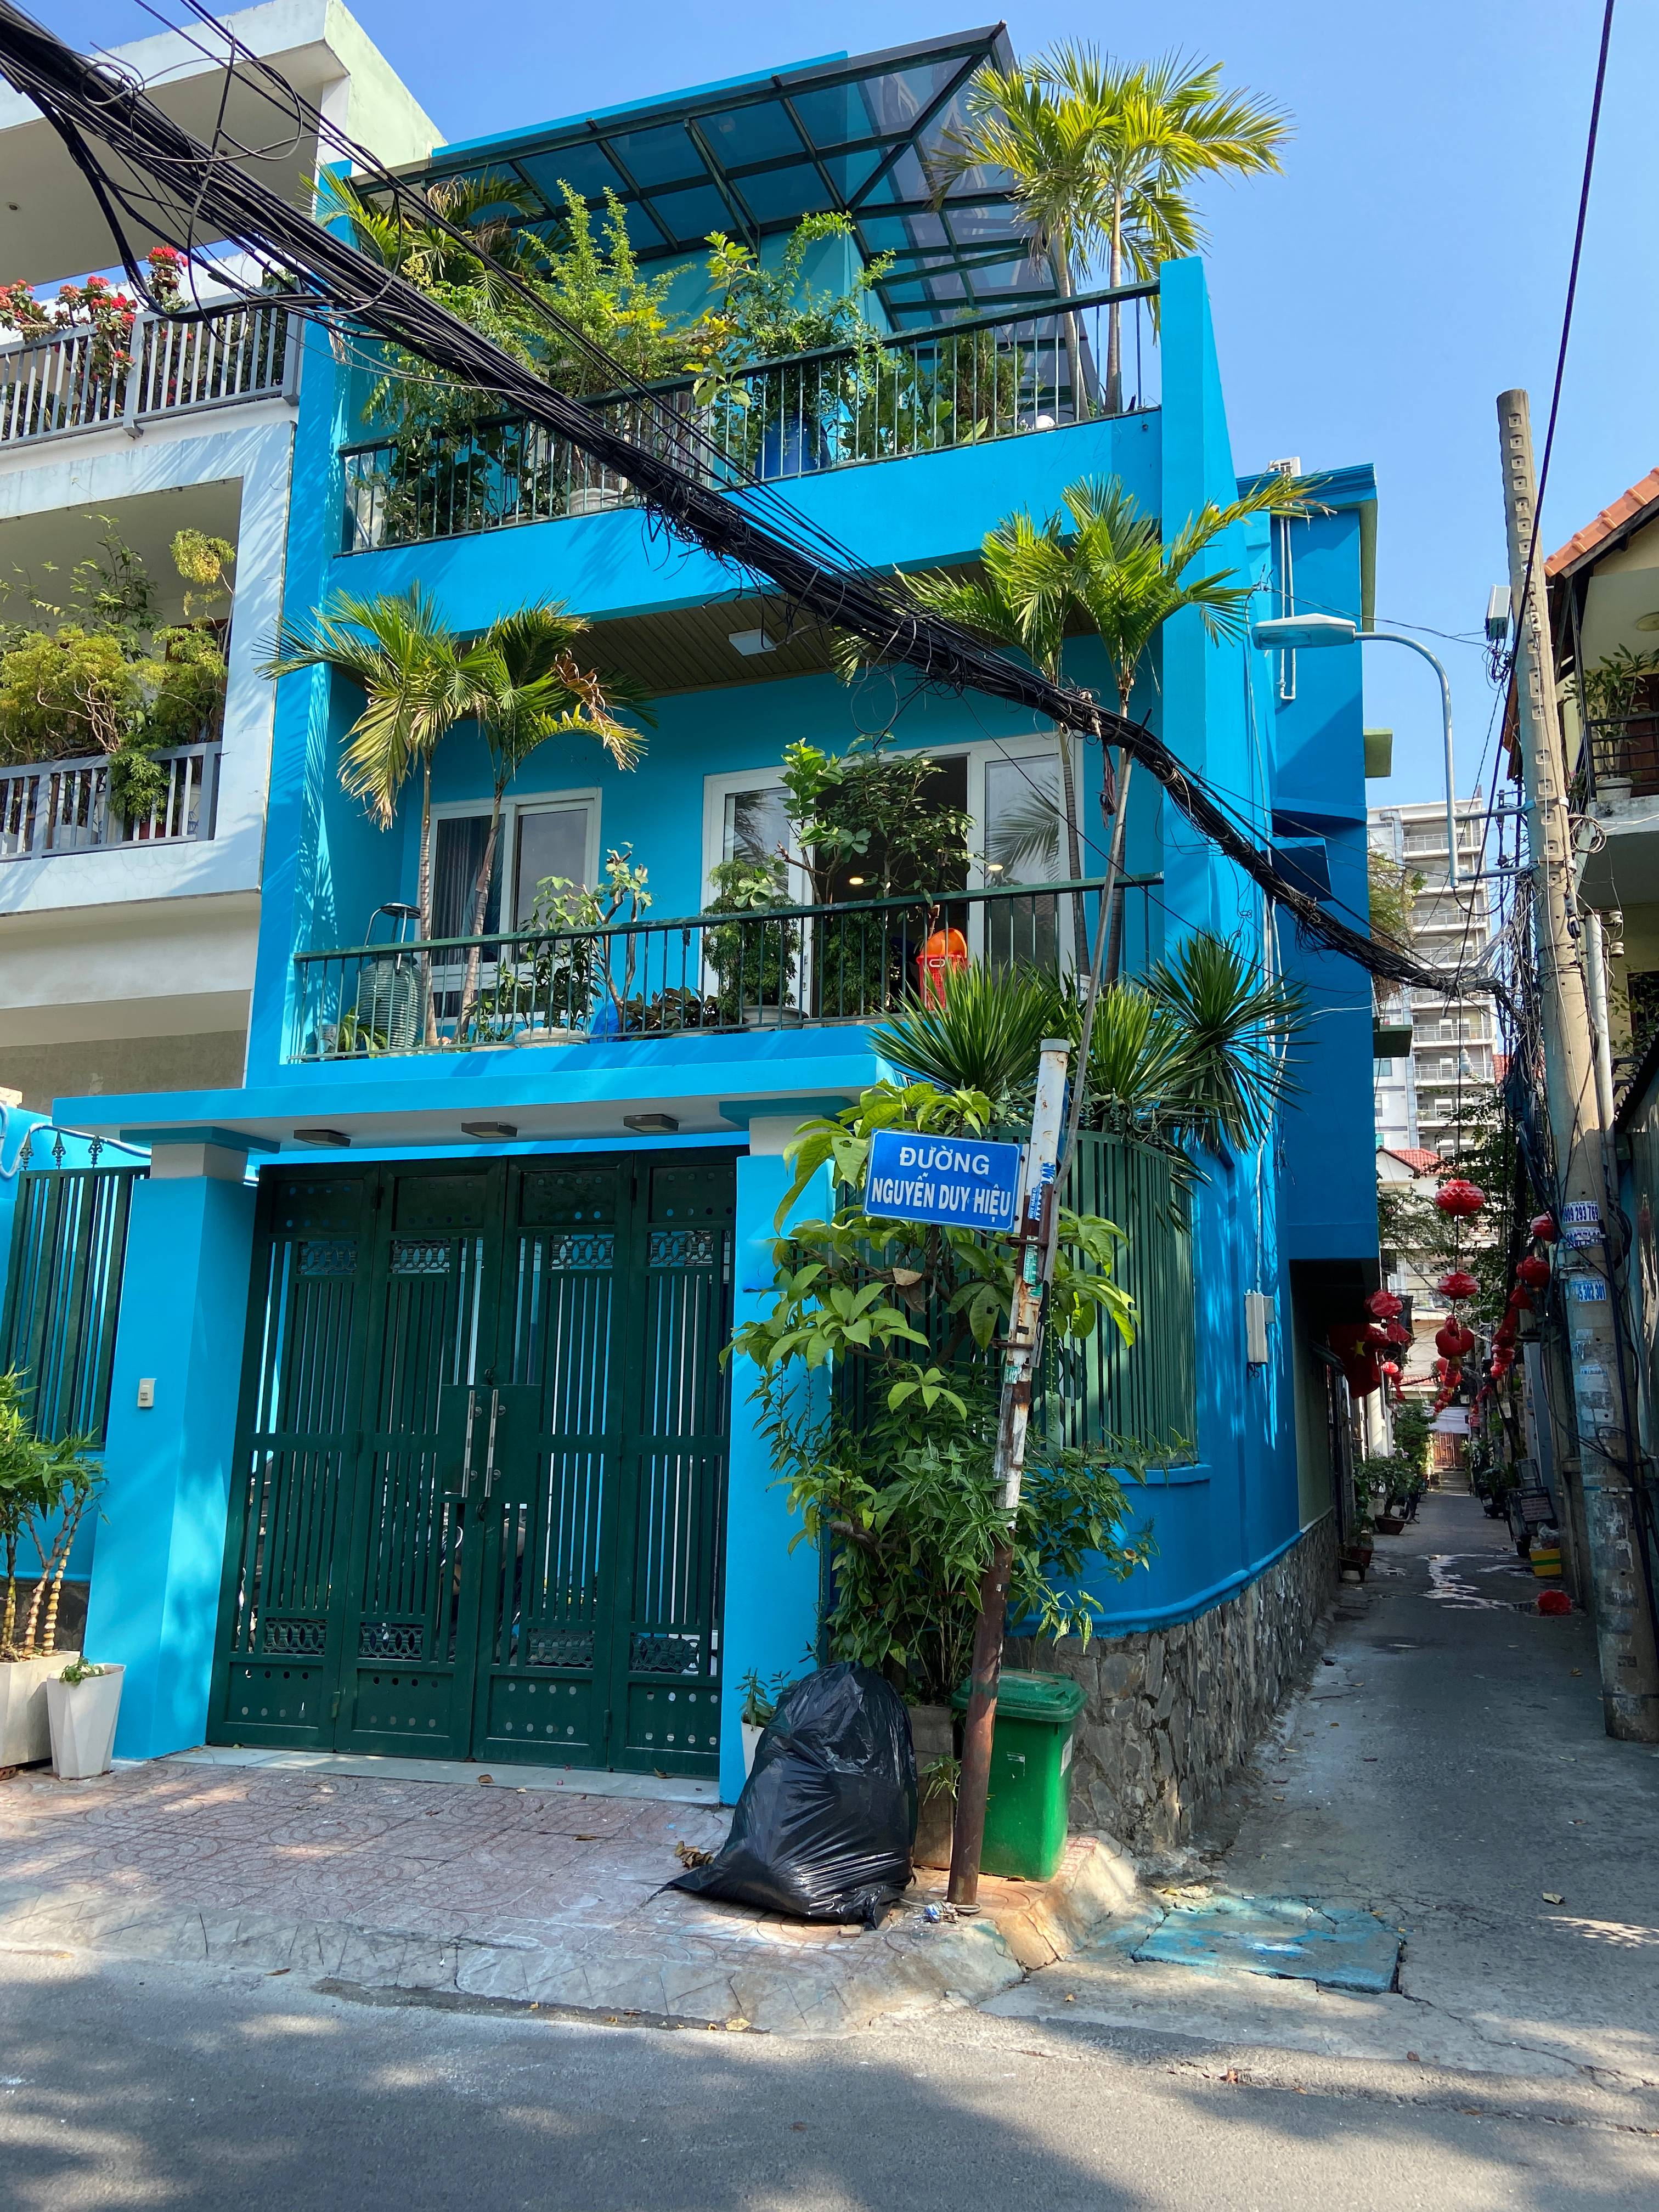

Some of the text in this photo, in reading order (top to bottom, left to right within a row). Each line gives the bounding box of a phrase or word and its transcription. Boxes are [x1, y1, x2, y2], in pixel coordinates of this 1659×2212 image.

[900, 1145, 990, 1175] ĐƯỜNG
[871, 1172, 935, 1208] NGUYỄN
[939, 1184, 970, 1212] DUY
[973, 1183, 1011, 1223] HIỆU
